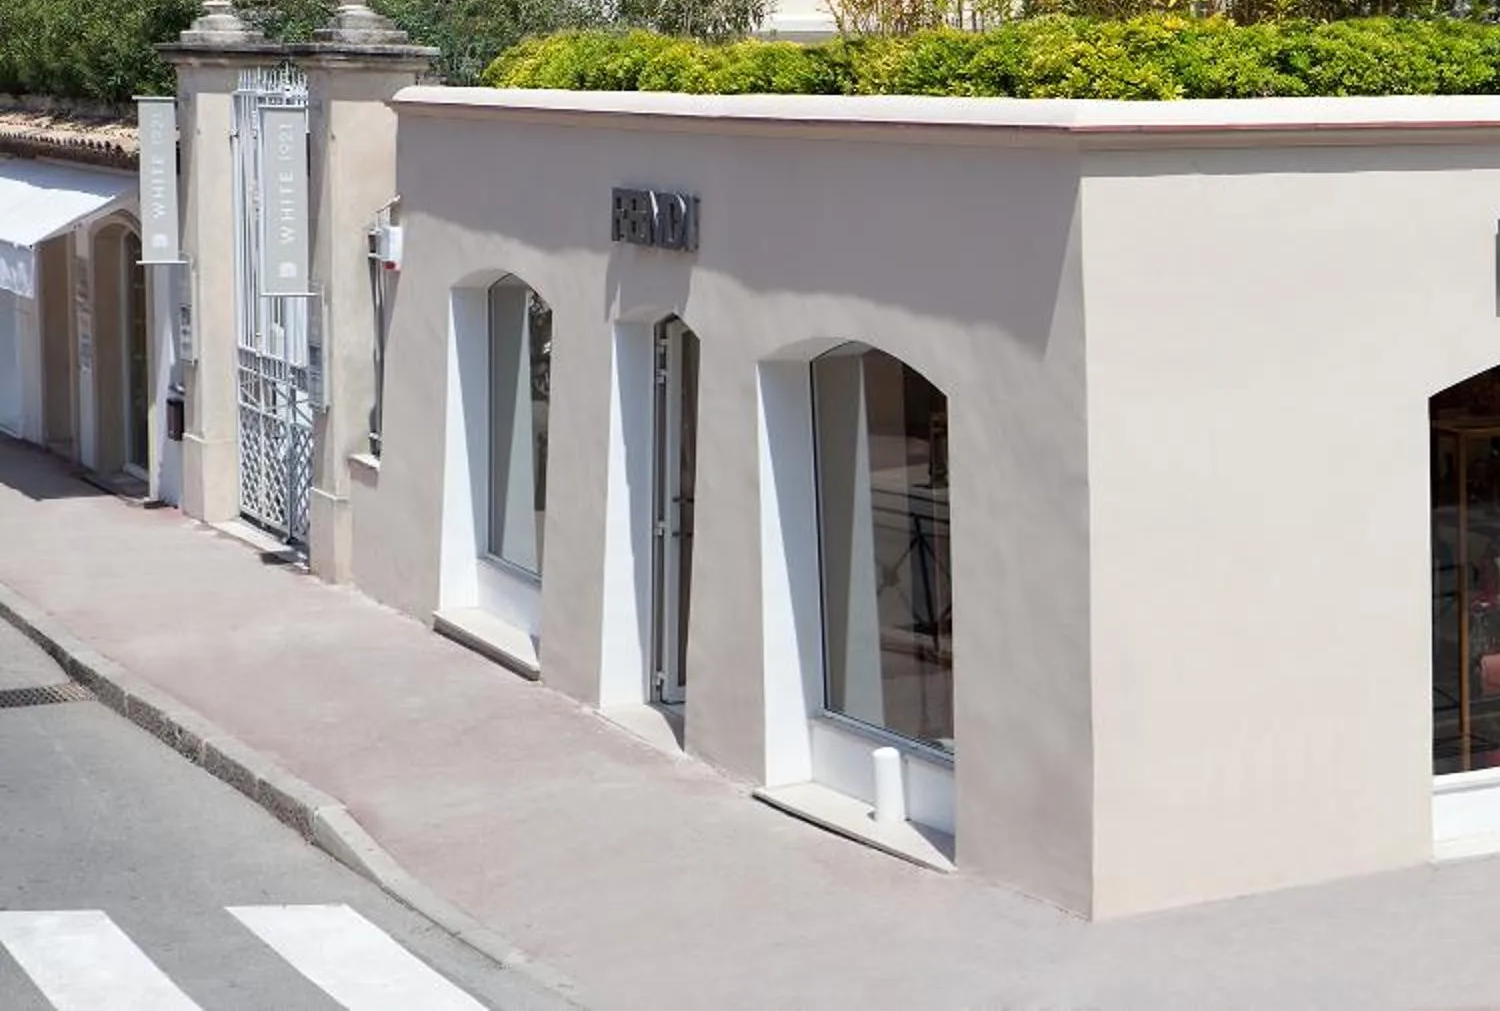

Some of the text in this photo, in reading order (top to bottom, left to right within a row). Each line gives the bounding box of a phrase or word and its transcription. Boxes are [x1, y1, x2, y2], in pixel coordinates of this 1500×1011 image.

[151, 154, 167, 219] WHITE
[278, 123, 296, 245] WHITE 1921
